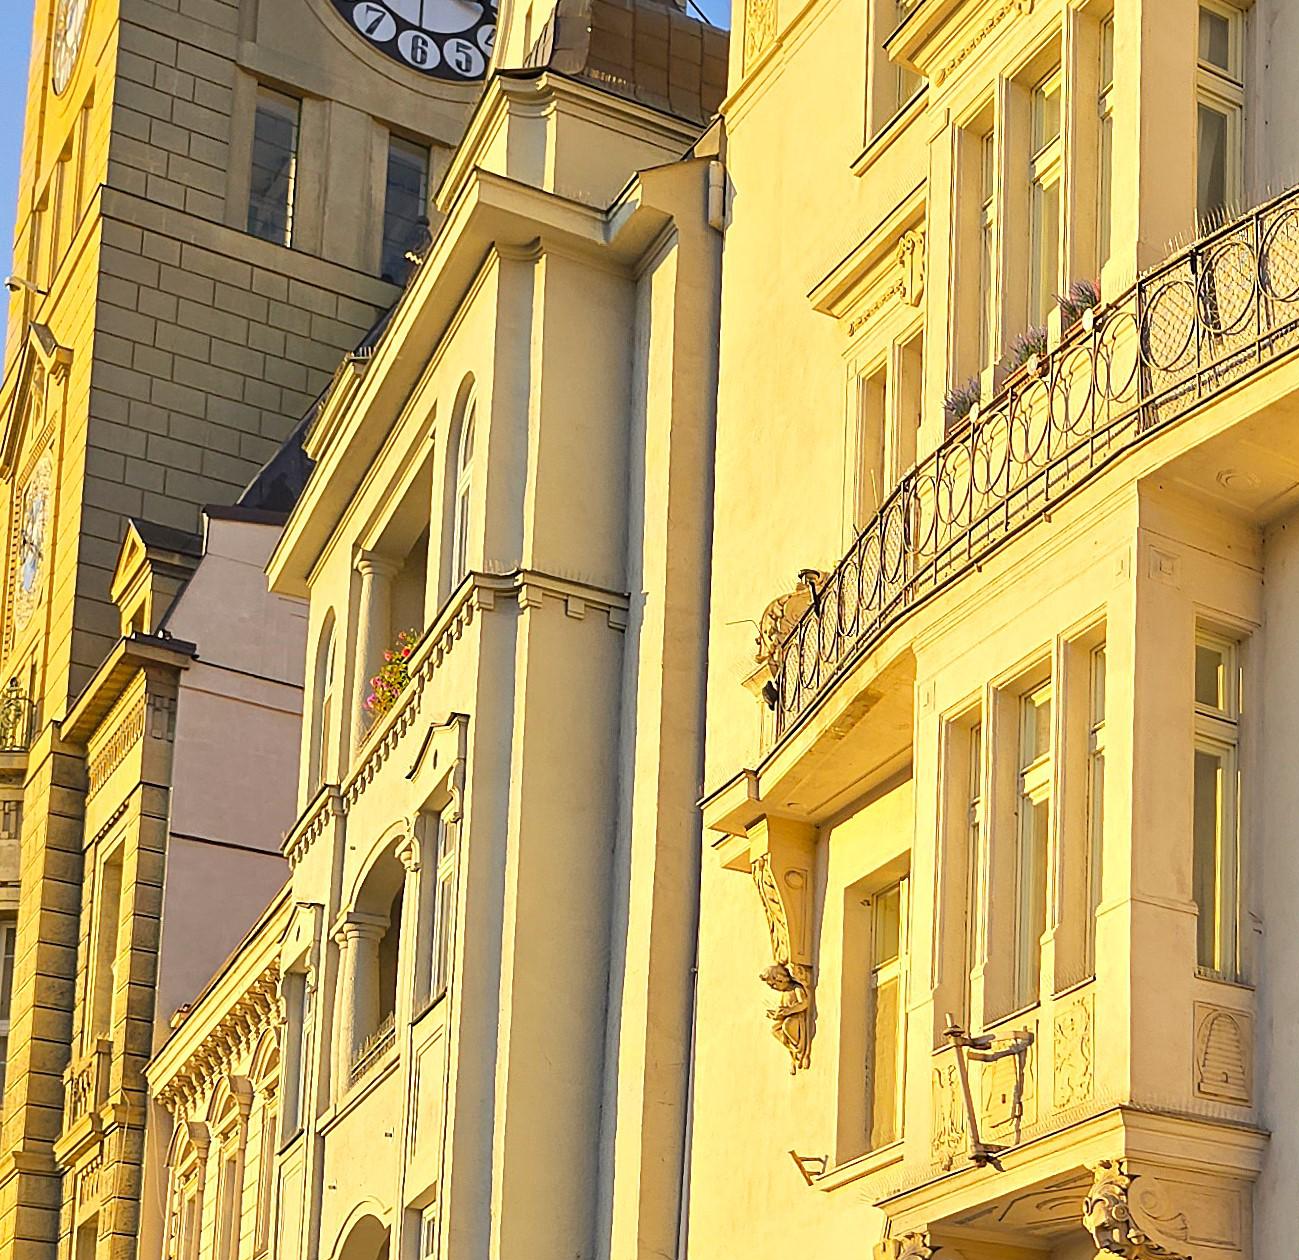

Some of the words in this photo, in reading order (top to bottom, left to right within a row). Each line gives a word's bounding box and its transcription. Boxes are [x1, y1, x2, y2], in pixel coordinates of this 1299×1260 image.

[365, 5, 387, 36] 7
[410, 34, 429, 65] 6
[455, 41, 473, 73] 5
